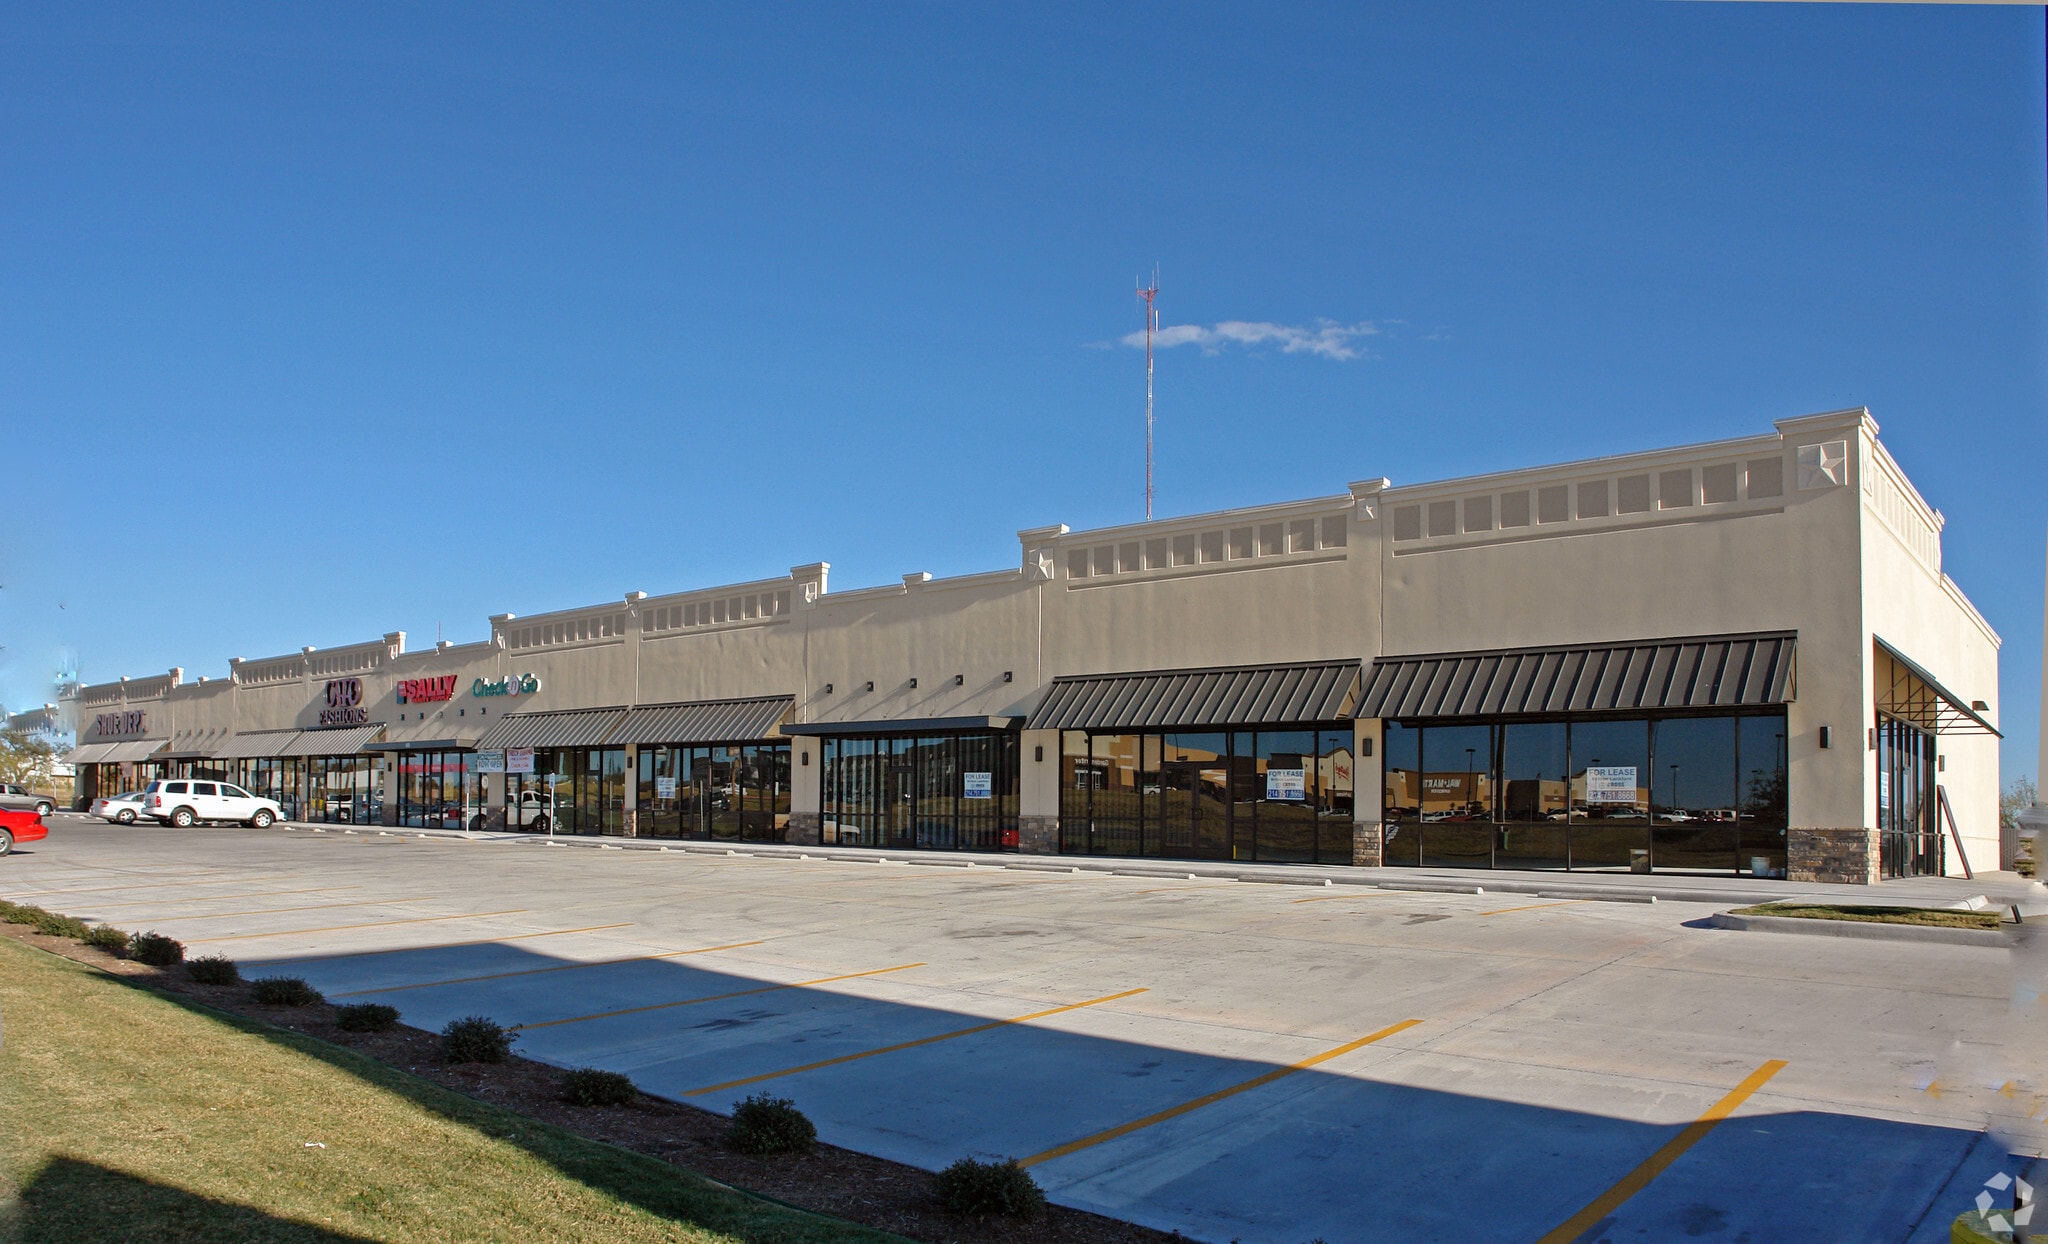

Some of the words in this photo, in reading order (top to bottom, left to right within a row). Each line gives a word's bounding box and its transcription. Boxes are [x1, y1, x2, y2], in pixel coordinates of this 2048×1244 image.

[406, 675, 457, 698] SALLY
[473, 676, 508, 698] Check
[521, 673, 539, 694] Go
[96, 713, 120, 735] SHOE
[319, 708, 368, 725] FASHIONS
